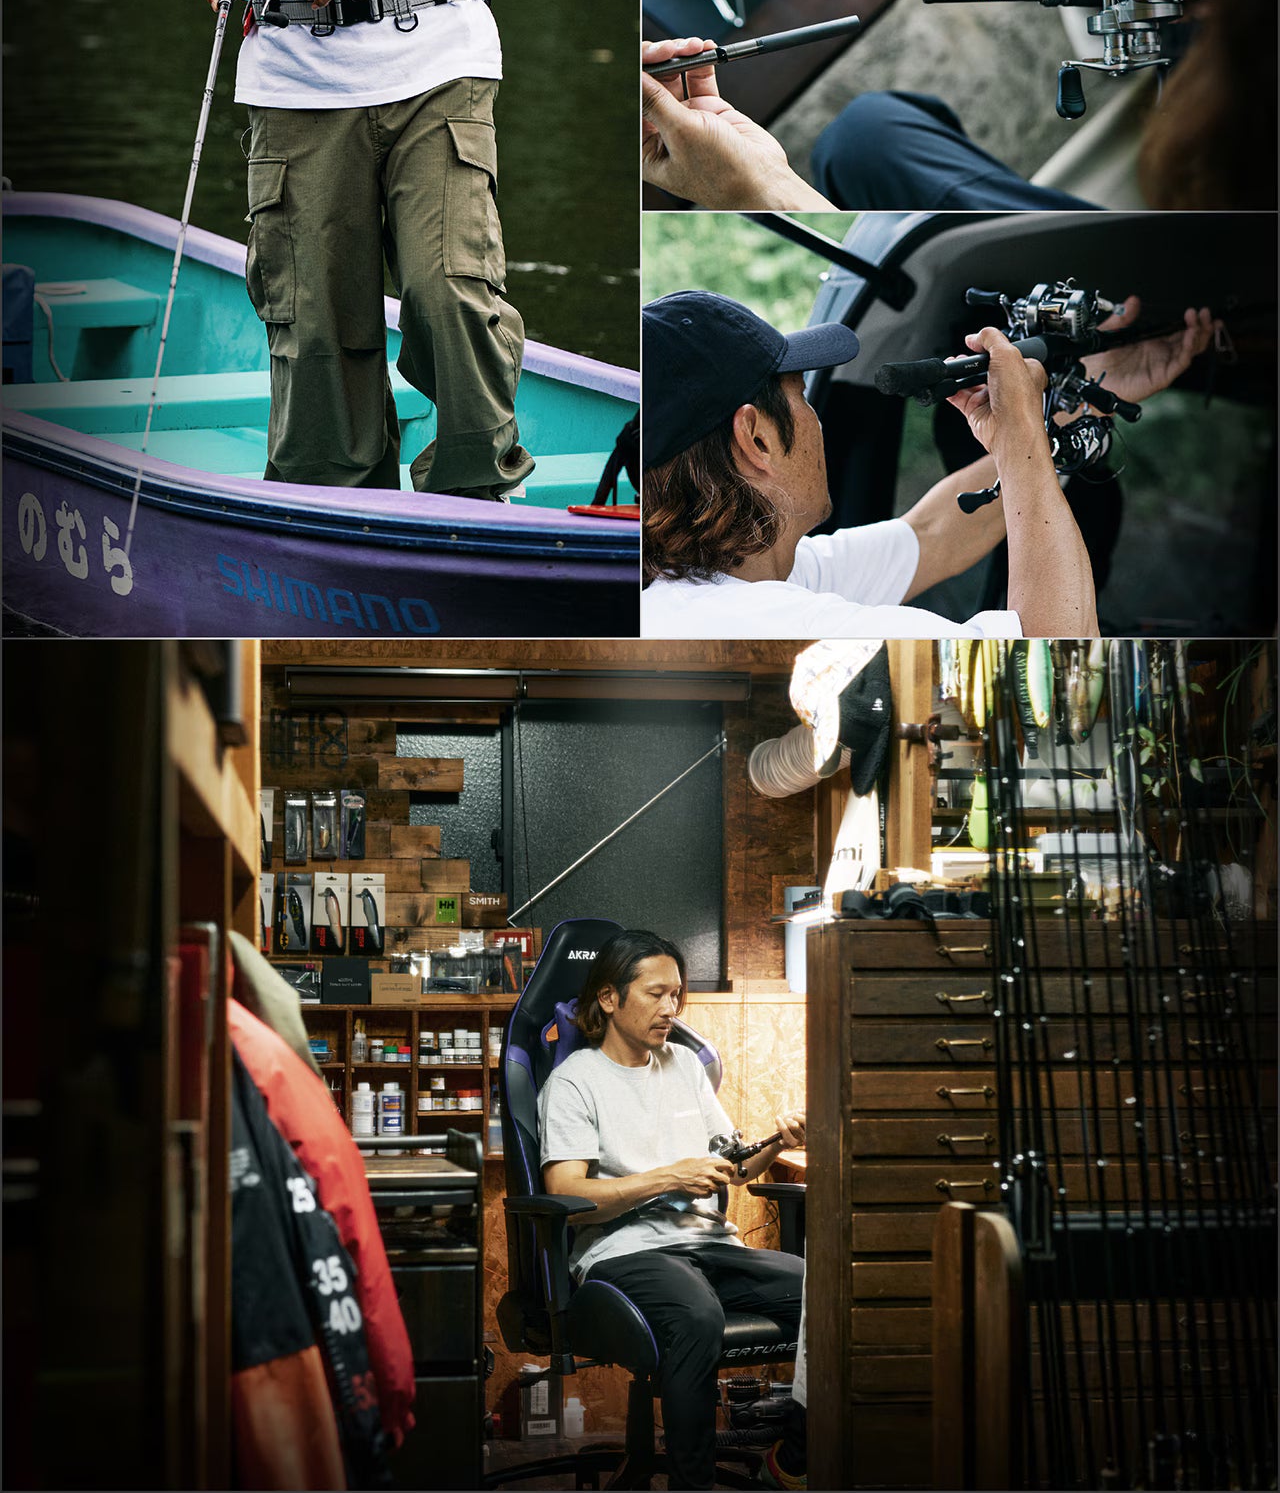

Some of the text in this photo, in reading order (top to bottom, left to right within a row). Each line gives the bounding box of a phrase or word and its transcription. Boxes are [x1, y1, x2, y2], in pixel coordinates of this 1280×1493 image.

[18, 492, 134, 596] のむら
[217, 553, 441, 634] SHIMANO
[439, 900, 455, 910] HH
[469, 897, 500, 906] SMITH
[312, 1256, 348, 1295] 35
[329, 1296, 362, 1335] 40
